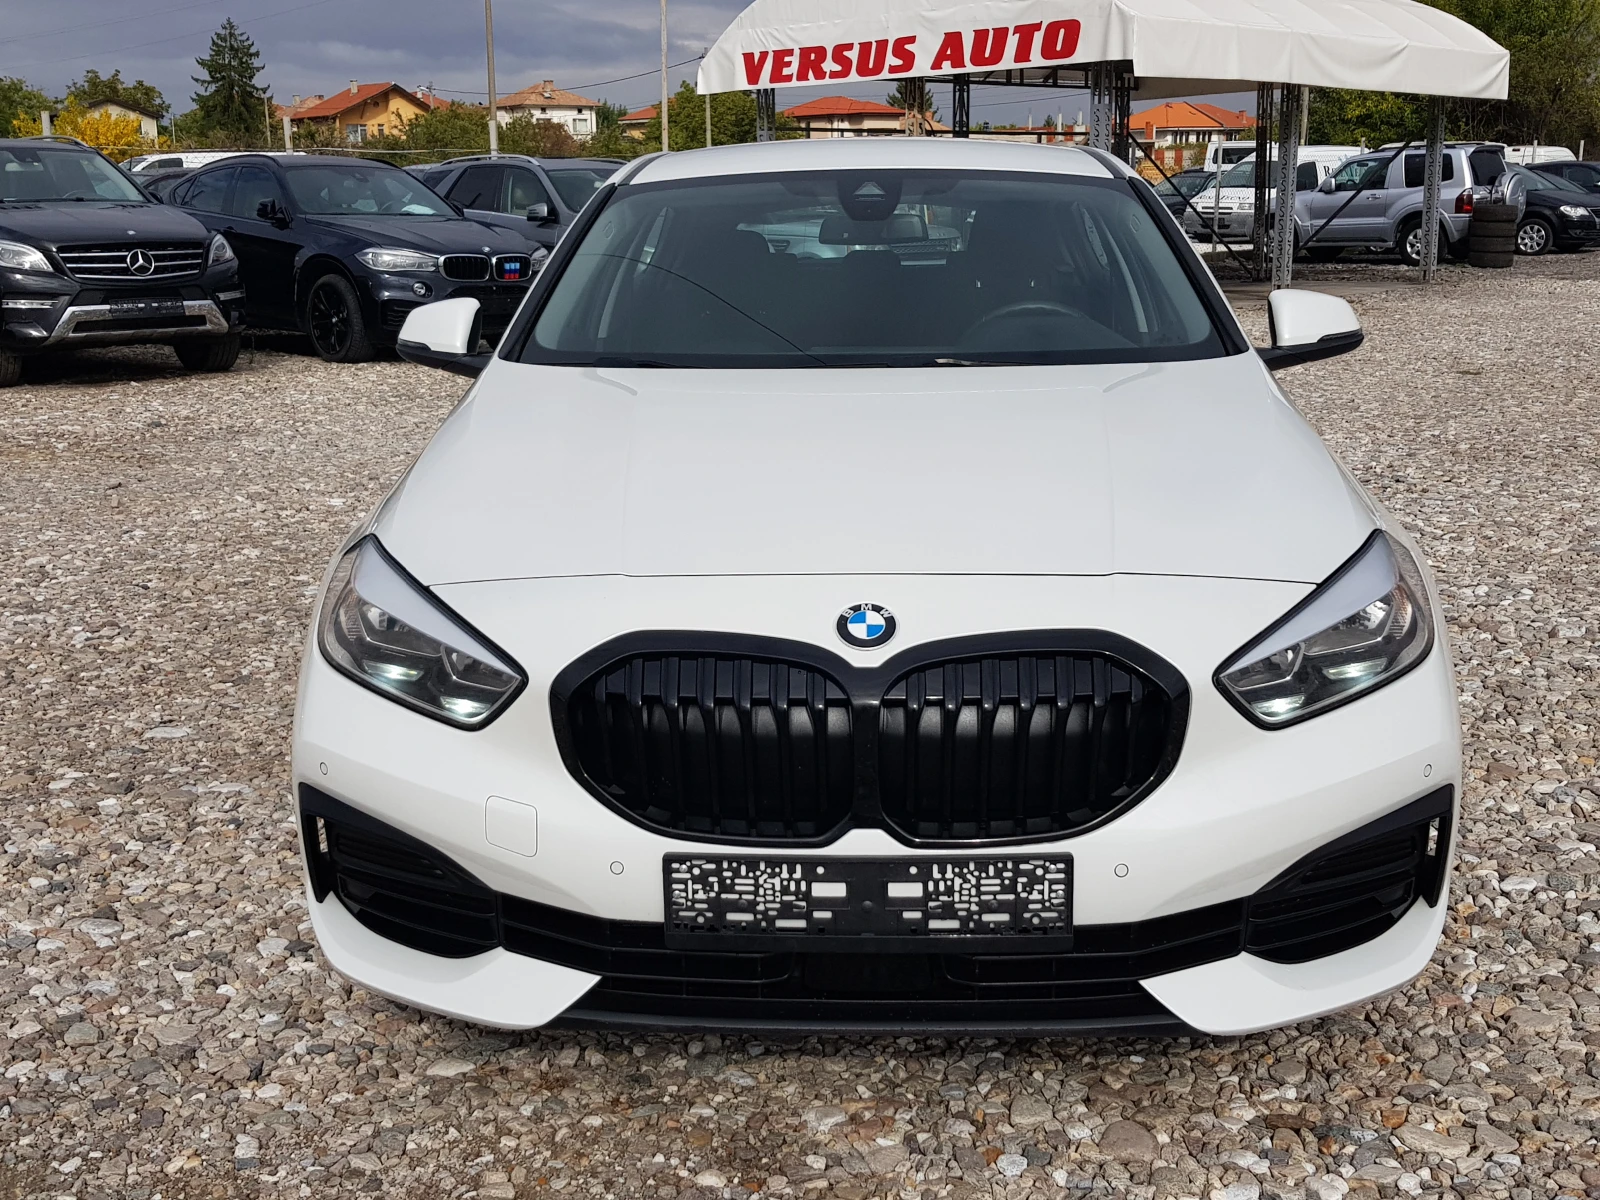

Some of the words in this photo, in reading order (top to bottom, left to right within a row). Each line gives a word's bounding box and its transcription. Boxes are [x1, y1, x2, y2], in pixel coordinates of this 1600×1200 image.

[742, 35, 917, 86] VERSUS
[930, 18, 1081, 71] AUTO
[841, 603, 893, 618] BMW
